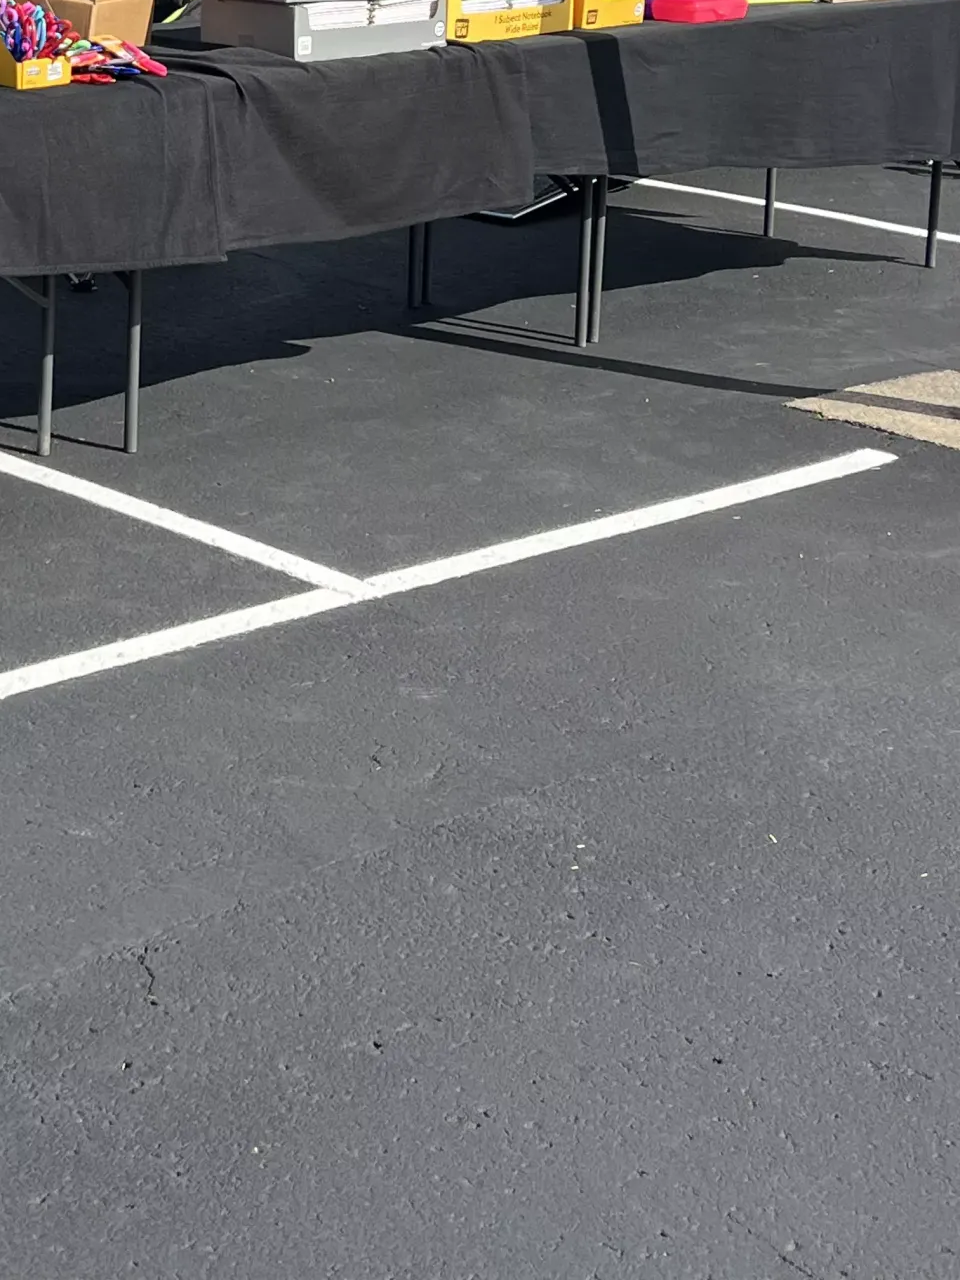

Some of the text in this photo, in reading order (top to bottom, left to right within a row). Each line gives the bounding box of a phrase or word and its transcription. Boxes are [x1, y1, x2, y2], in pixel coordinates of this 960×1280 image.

[499, 13, 521, 24] Subject
[522, 8, 553, 21] Notebook
[505, 23, 520, 34] Wide
